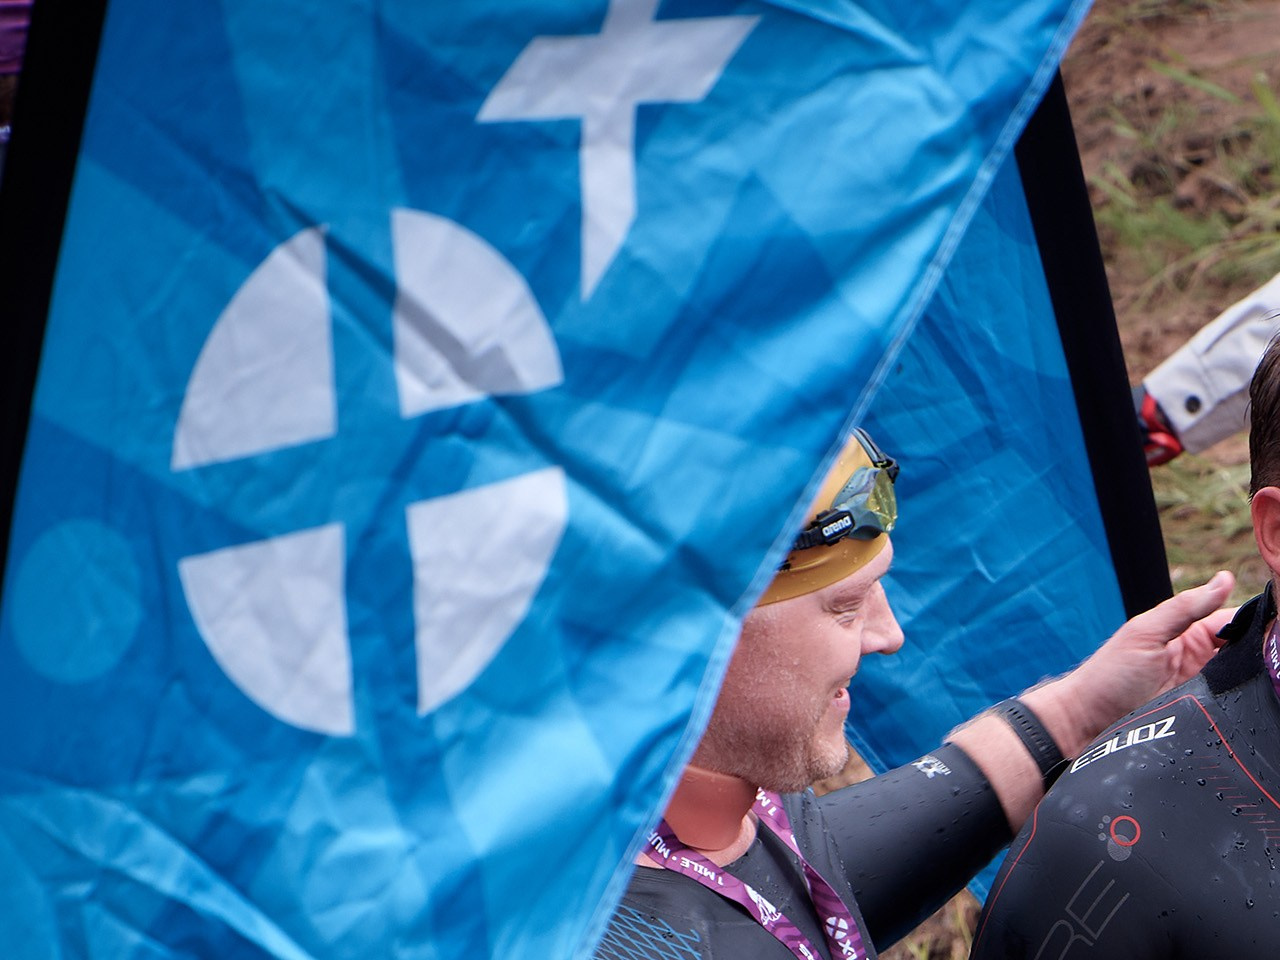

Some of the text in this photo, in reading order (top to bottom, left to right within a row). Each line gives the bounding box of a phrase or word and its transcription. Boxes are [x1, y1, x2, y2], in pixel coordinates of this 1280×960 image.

[822, 516, 852, 537] arena
[1070, 715, 1176, 774] ZONE3
[680, 857, 716, 880] MILE
[717, 876, 724, 886] 1
